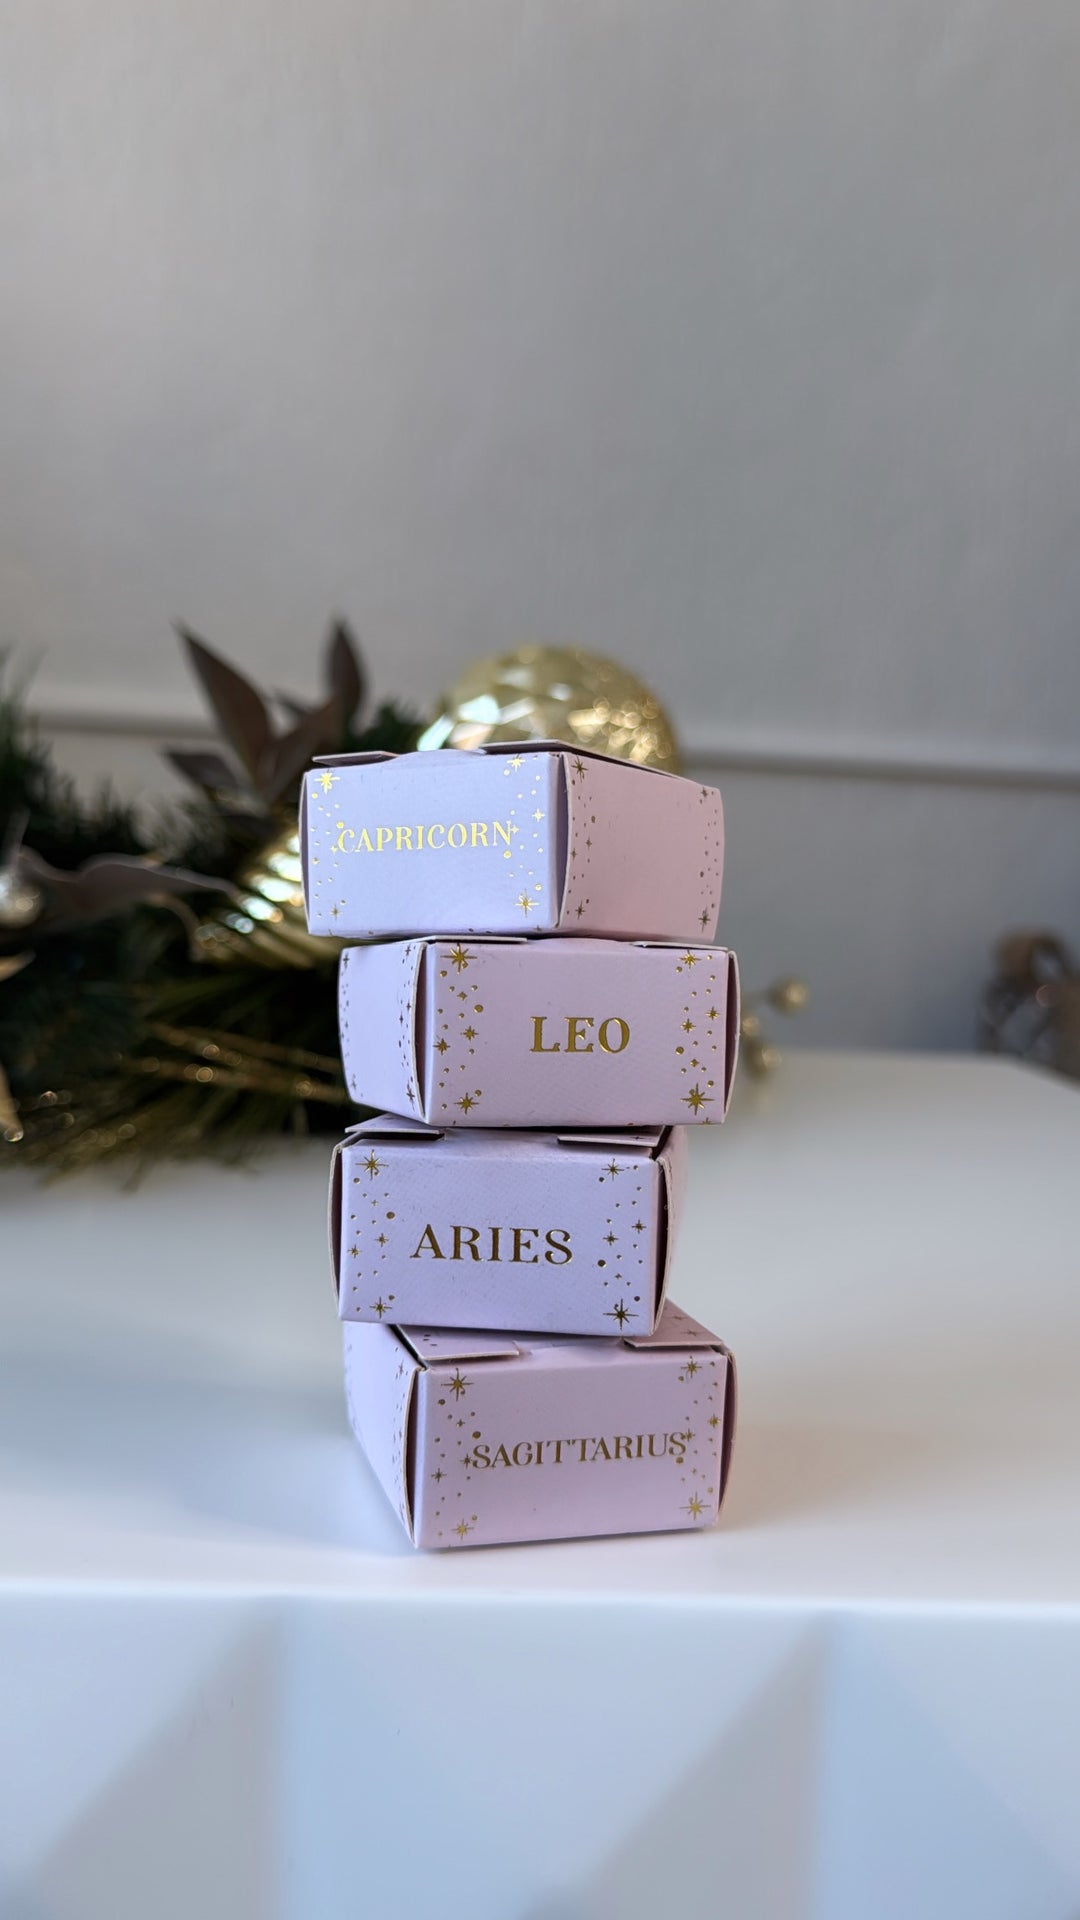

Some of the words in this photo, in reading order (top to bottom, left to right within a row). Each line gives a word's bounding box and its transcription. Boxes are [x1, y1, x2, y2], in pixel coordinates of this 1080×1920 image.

[337, 820, 513, 854] CAPRICORN
[529, 1016, 631, 1054] LEO
[409, 1223, 574, 1266] ARIES
[472, 1431, 687, 1470] SAGITTARIUS
